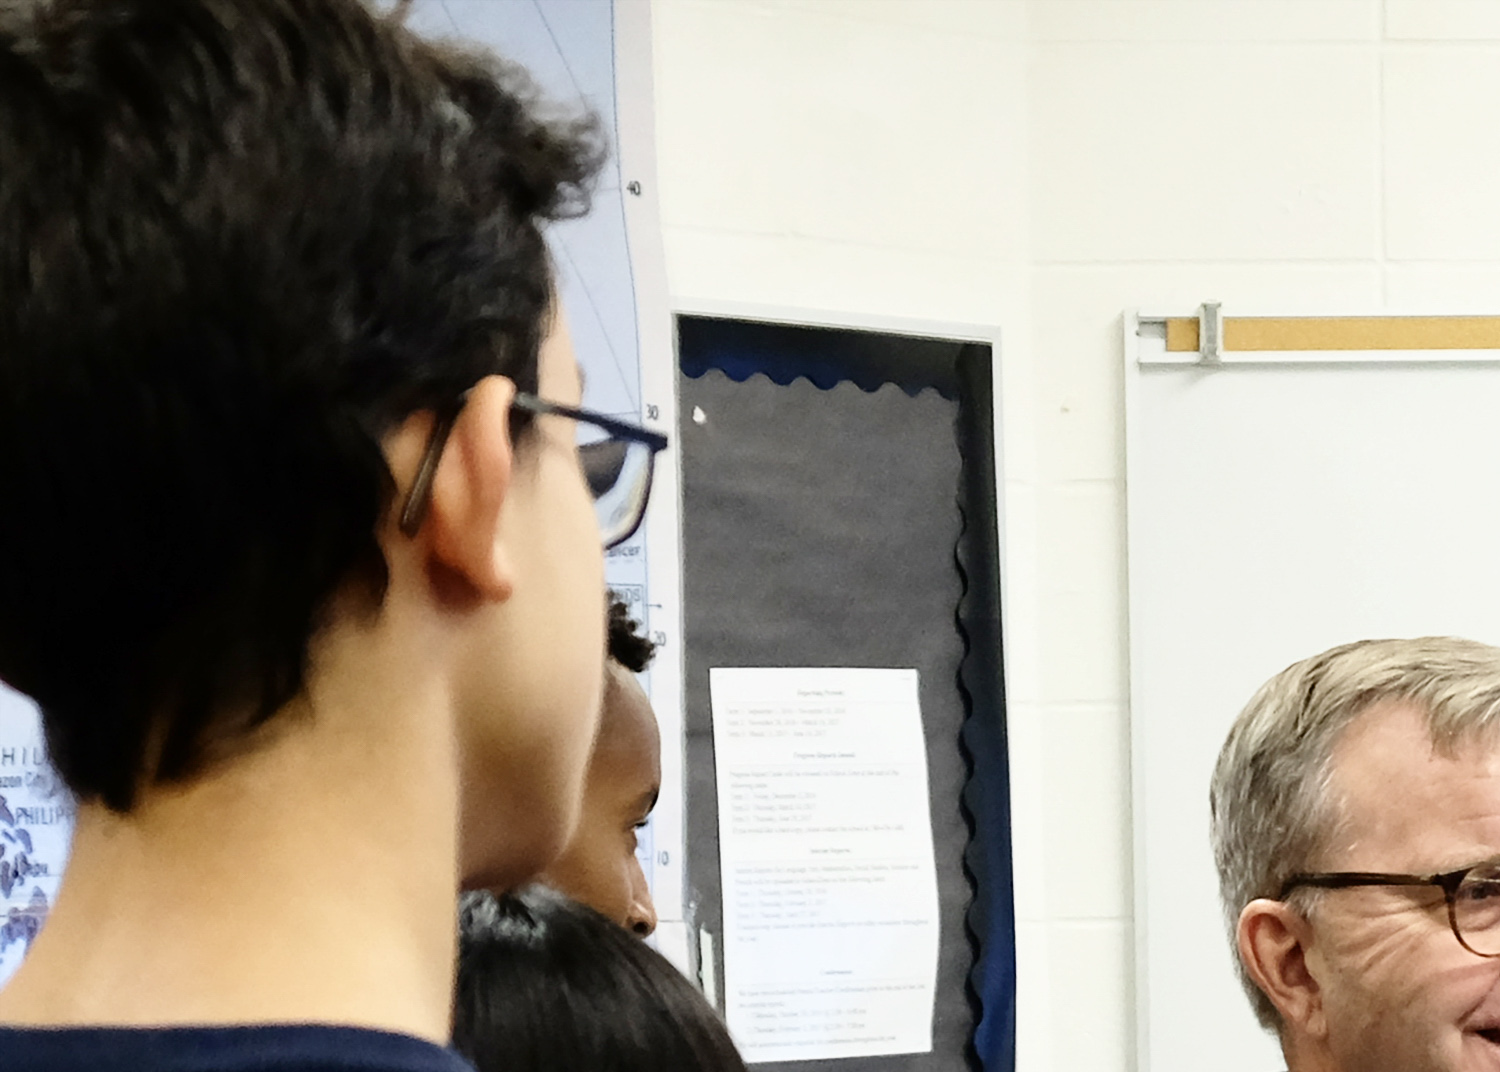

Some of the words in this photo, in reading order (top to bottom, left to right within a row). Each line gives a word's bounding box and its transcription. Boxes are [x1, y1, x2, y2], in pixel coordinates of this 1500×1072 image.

[626, 180, 641, 196] 40
[646, 403, 659, 420] 30
[657, 850, 669, 866] 10
